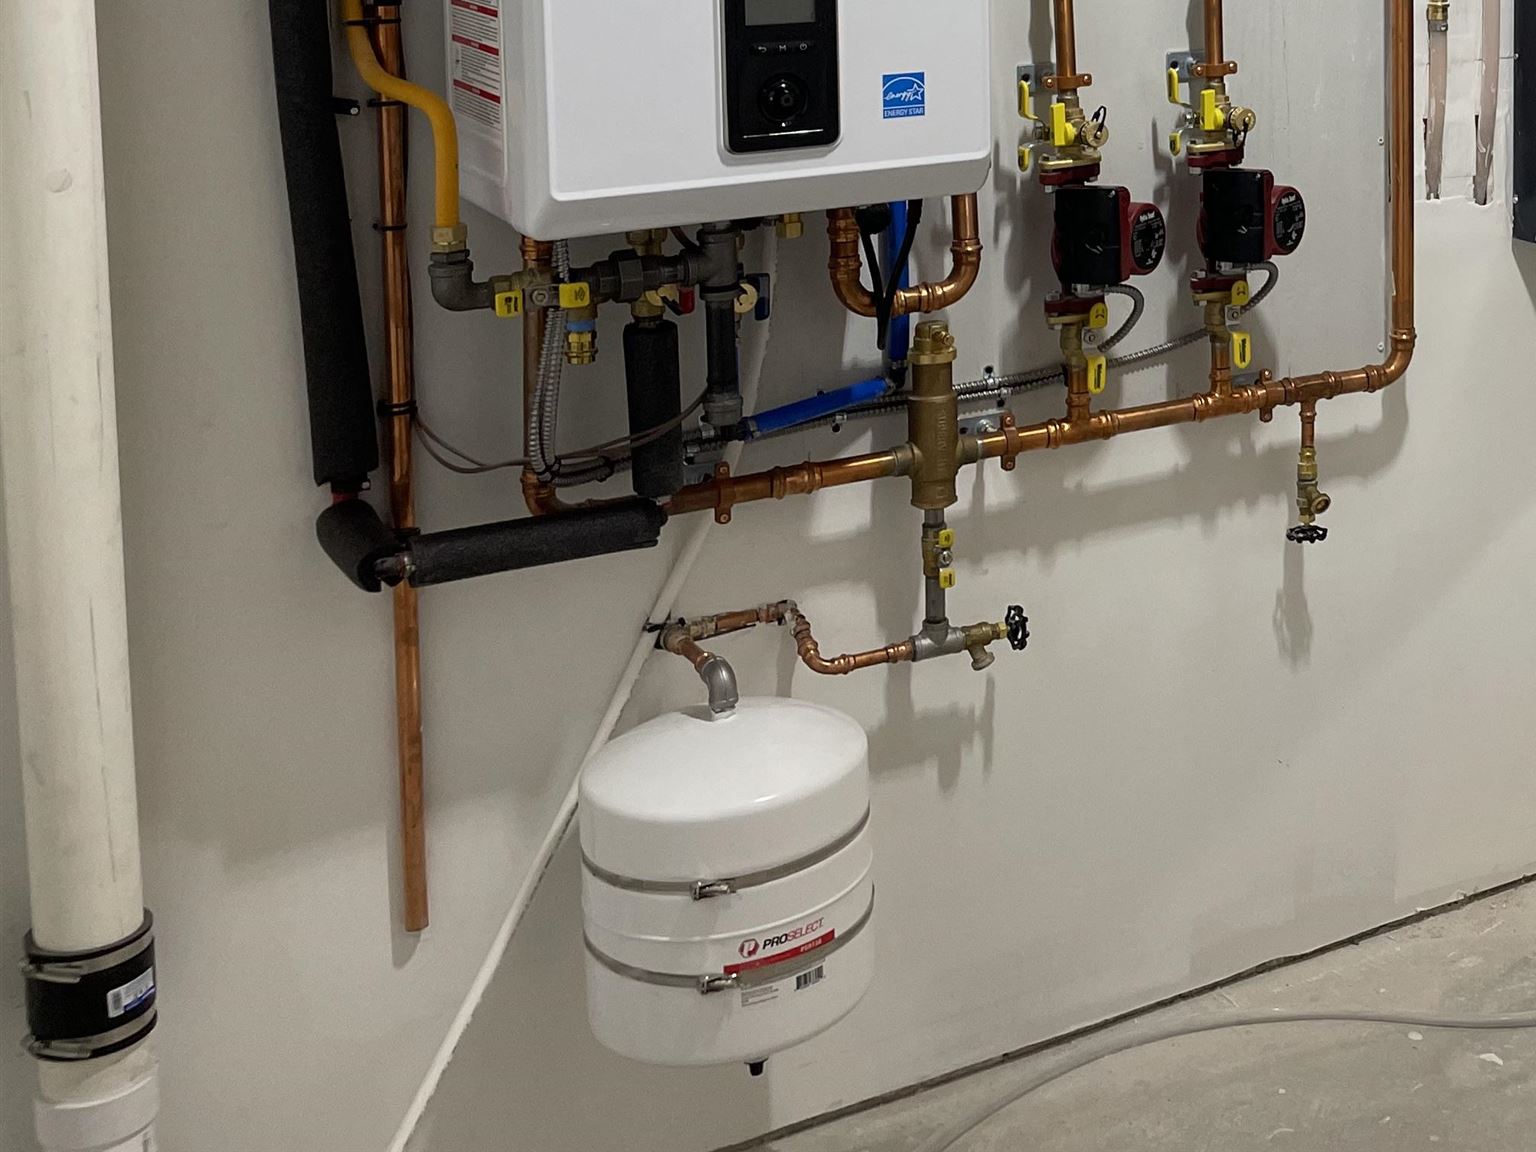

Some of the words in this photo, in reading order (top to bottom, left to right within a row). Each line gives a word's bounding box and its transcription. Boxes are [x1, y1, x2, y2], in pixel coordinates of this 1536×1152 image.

[884, 109, 908, 118] ENERGY
[908, 107, 924, 116] STAR
[761, 917, 824, 950] PROSELECT
